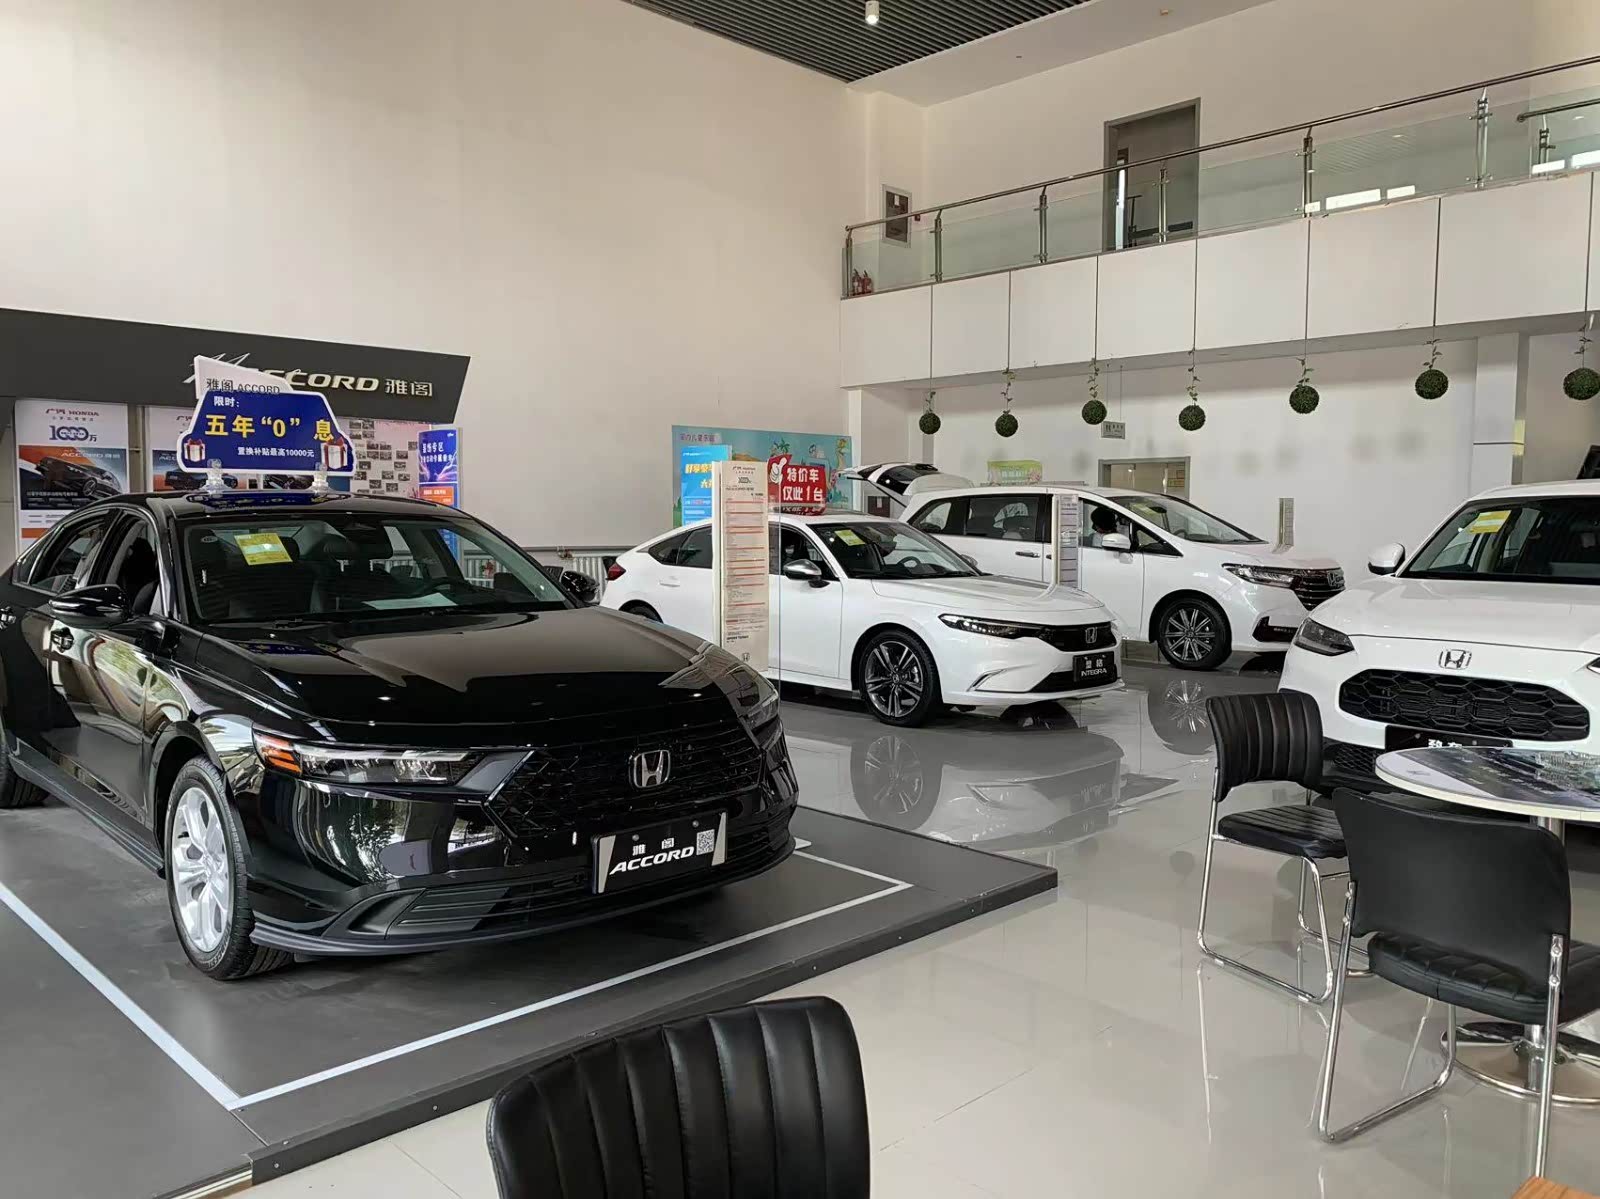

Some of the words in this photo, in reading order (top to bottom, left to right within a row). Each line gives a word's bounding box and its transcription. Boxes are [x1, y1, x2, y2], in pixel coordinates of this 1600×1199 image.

[206, 378, 234, 392] 雅阁
[237, 383, 281, 394] ACCORD
[386, 378, 433, 397] 雅阁
[237, 446, 315, 458] 置换补贴最高10000元
[786, 467, 820, 483] 特价车
[782, 485, 824, 502] 仅此1台
[1081, 667, 1107, 677] INTEGRA
[609, 846, 695, 875] ACCORD
